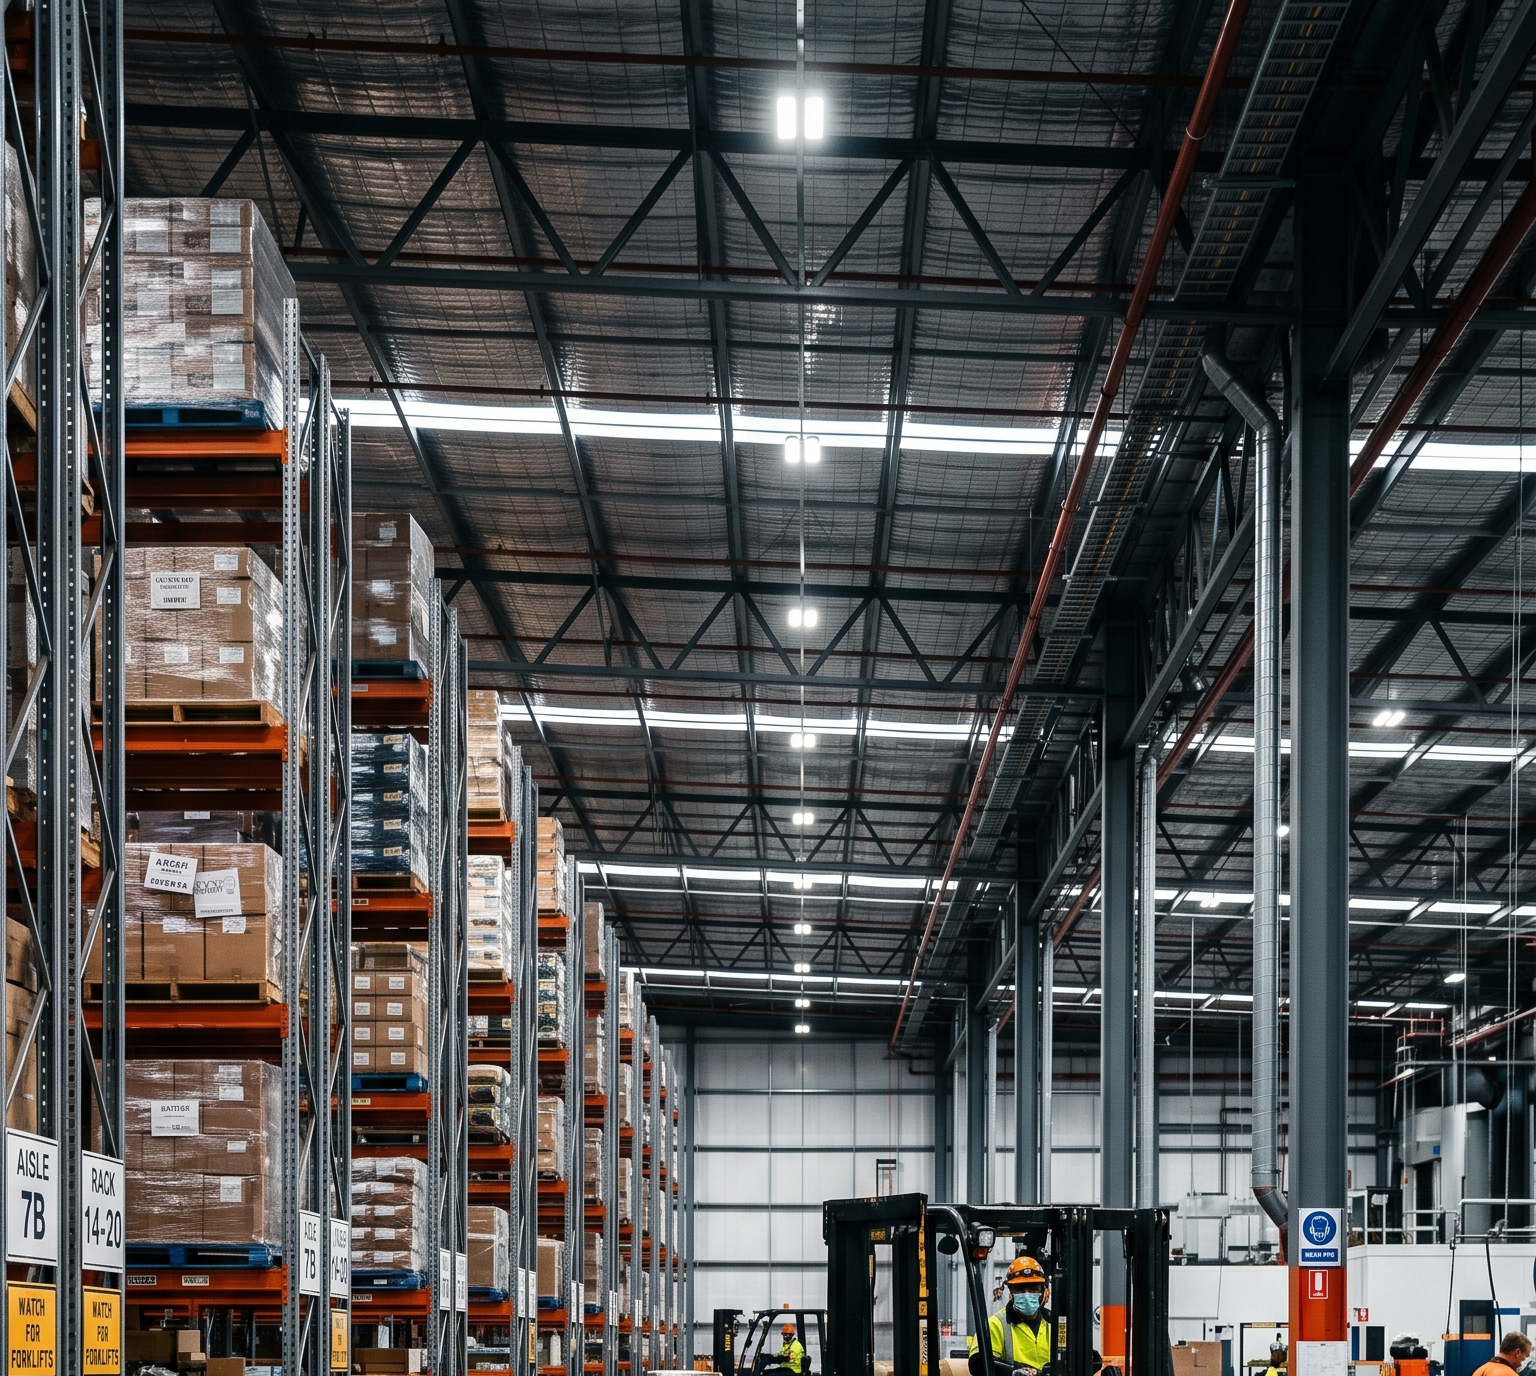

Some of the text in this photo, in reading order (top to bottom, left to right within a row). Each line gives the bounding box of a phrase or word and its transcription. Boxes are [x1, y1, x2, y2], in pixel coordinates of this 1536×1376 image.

[16, 1148, 50, 1181] AISLE
[91, 1167, 116, 1197] RACK
[21, 1190, 46, 1240] 7B
[84, 1205, 122, 1249] 14-20
[304, 1248, 316, 1279] 7B
[18, 1297, 45, 1317] WATCH
[92, 1301, 113, 1319] WATCH
[25, 1324, 41, 1342] FOR
[11, 1349, 54, 1368] FORKLIFTS
